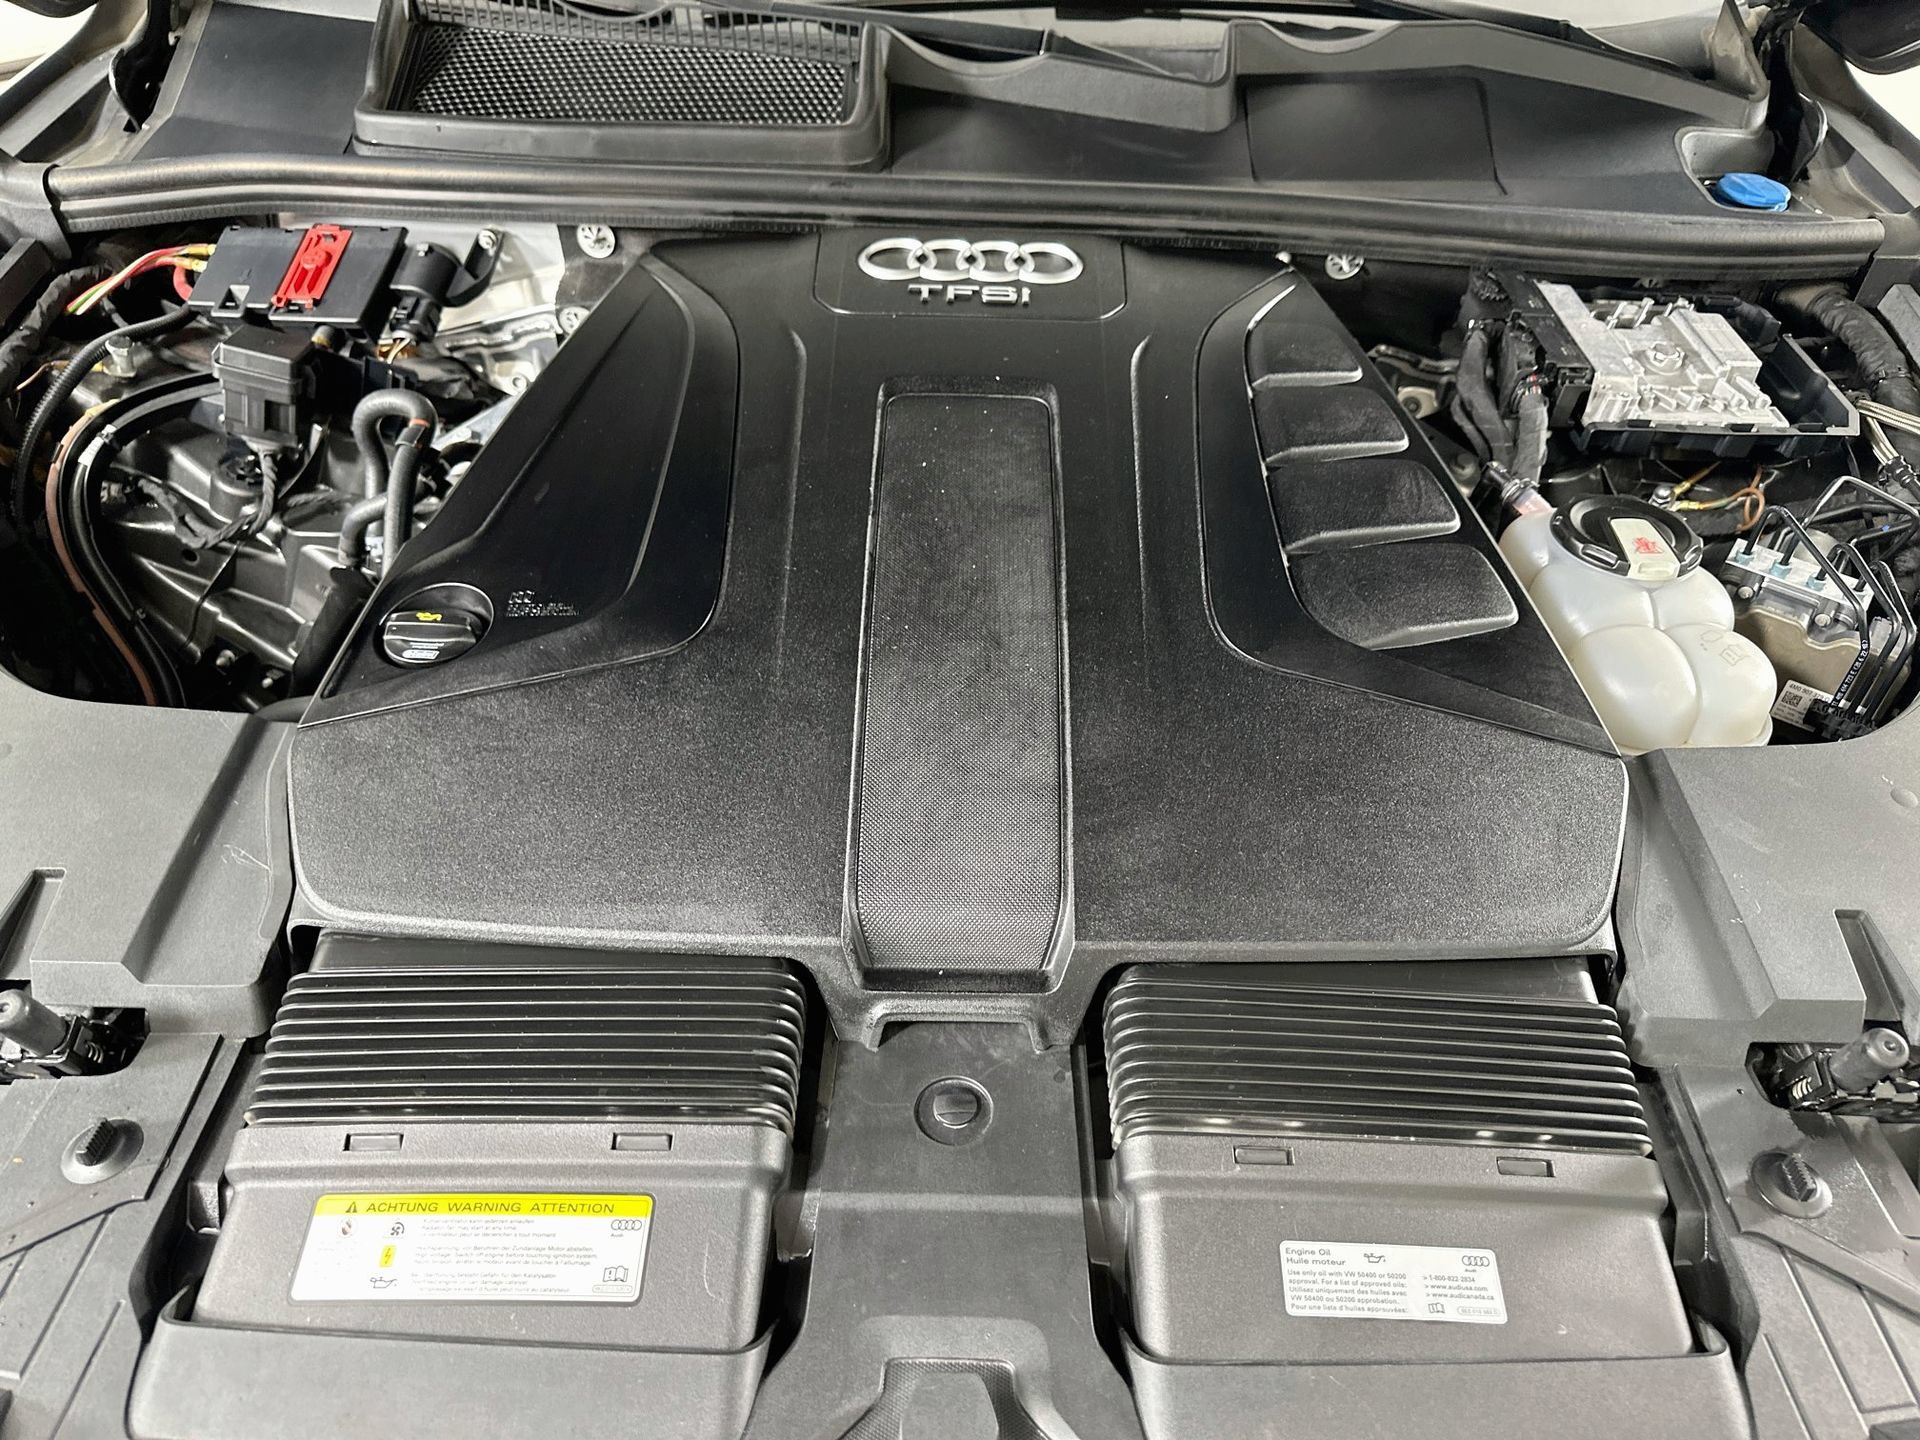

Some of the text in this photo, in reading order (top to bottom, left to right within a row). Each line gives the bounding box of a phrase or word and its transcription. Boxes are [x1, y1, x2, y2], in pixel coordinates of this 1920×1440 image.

[907, 283, 1031, 305] TFSI
[366, 1202, 615, 1213] ACHTUNG WARNING ATTENTION
[1285, 1247, 1331, 1256] Engine Oil
[1286, 1257, 1309, 1265] Huile
[1302, 1269, 1317, 1278] only
[1387, 1272, 1407, 1280] 50200
[1288, 1278, 1320, 1286] approval.
[1315, 1287, 1355, 1295] uniquement
